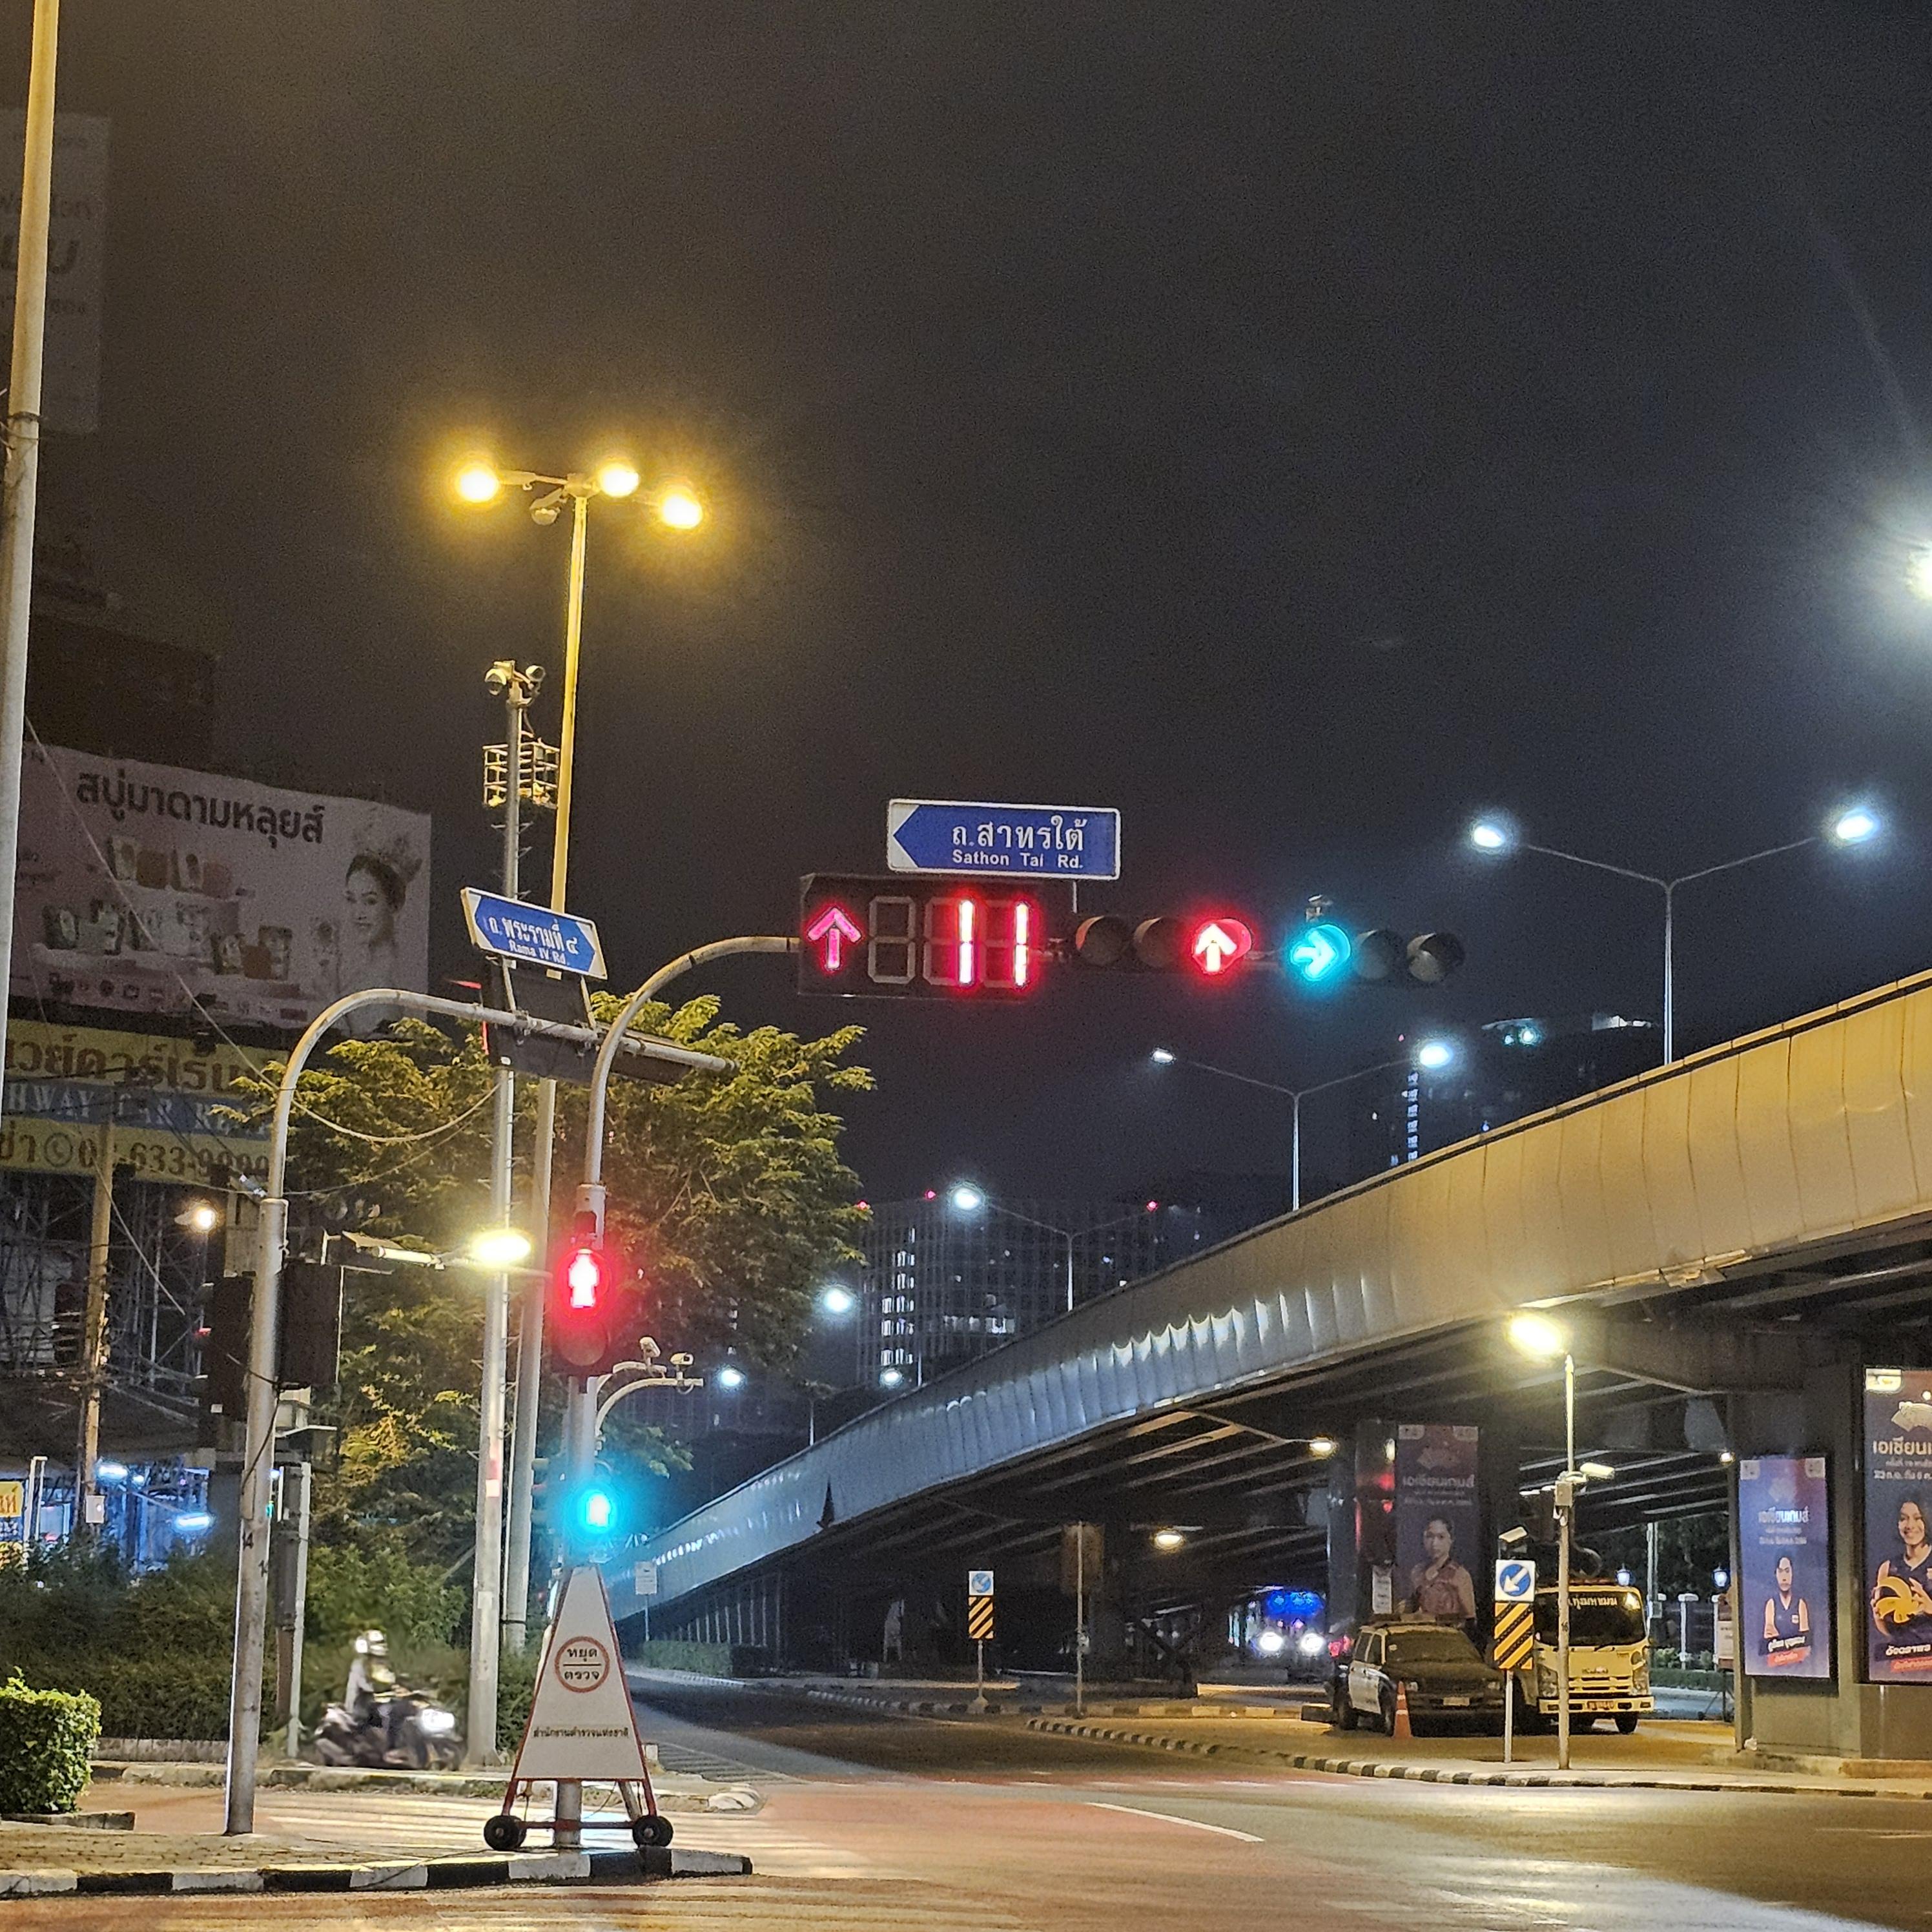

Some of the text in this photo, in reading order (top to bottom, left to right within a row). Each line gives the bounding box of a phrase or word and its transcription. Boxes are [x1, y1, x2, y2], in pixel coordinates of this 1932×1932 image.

[77, 768, 324, 848] สบู่มาดามหลุยส์
[952, 815, 1087, 850] ถ.สาทรใต้
[952, 849, 1084, 868] Sathon Tai Rd.
[509, 939, 570, 965] Rama IV Rd.
[958, 899, 1029, 987] 11
[567, 1648, 597, 1662] หยุด
[564, 1670, 599, 1680] ตรวจ
